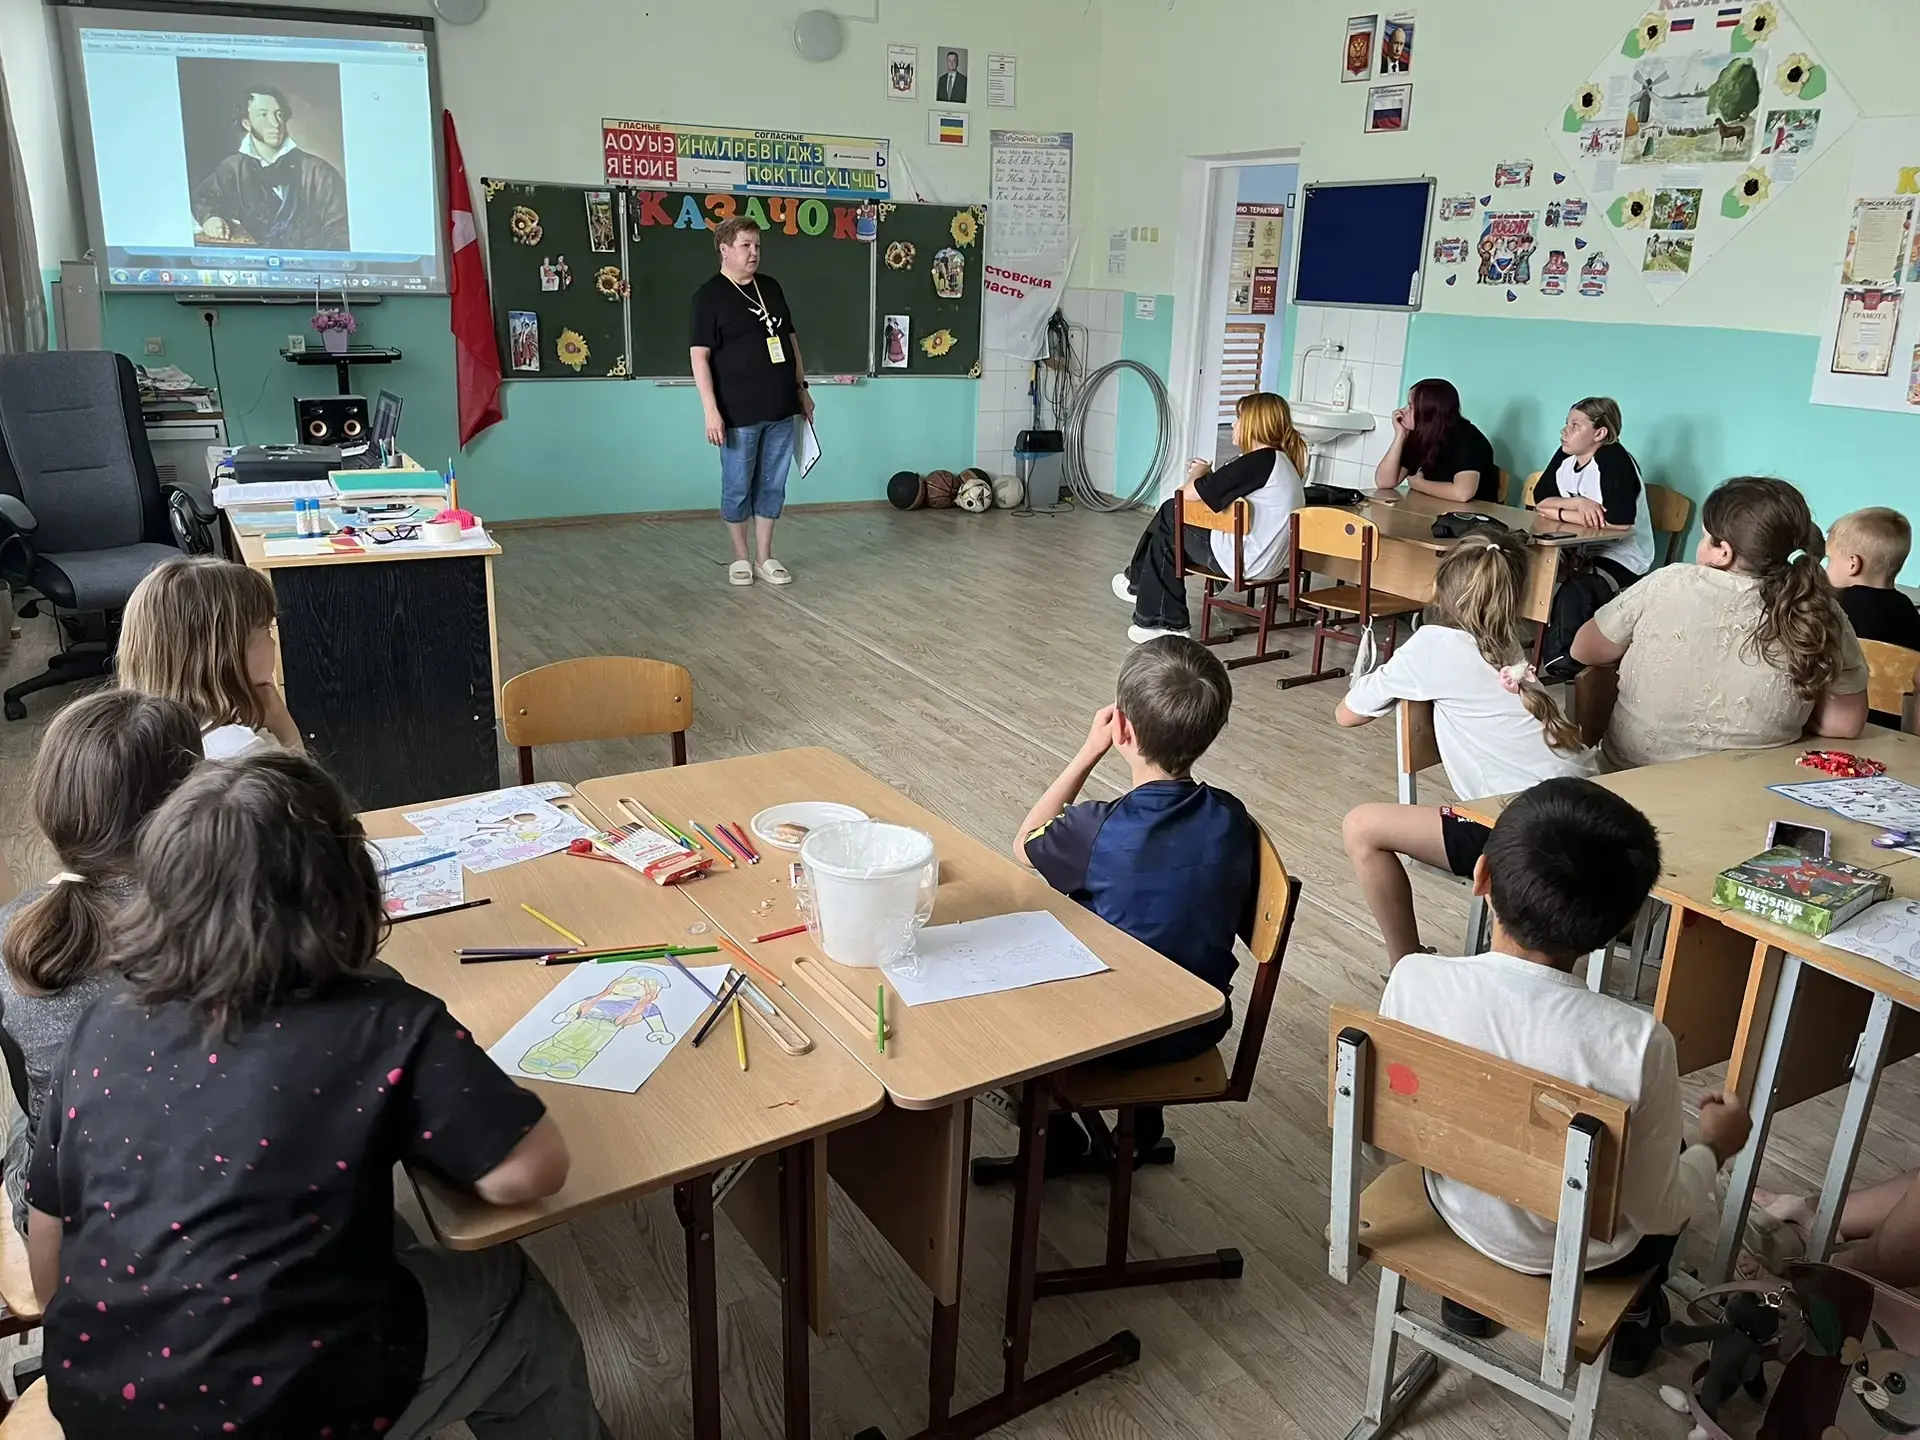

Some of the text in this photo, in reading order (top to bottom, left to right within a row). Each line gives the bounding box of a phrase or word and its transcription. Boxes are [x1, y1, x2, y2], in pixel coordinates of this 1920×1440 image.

[618, 122, 661, 131] ГЛАСНЫЕ
[754, 131, 804, 142] СОГЛАСНЫЕ
[637, 191, 858, 240] КАЗАЧОК
[1250, 206, 1279, 215] ТЕРАКТОВ
[1259, 285, 1272, 294] 112
[1852, 312, 1887, 320] ГРАМОТА
[1737, 885, 1803, 917] DINOSAUR
[1744, 899, 1768, 915] SET
